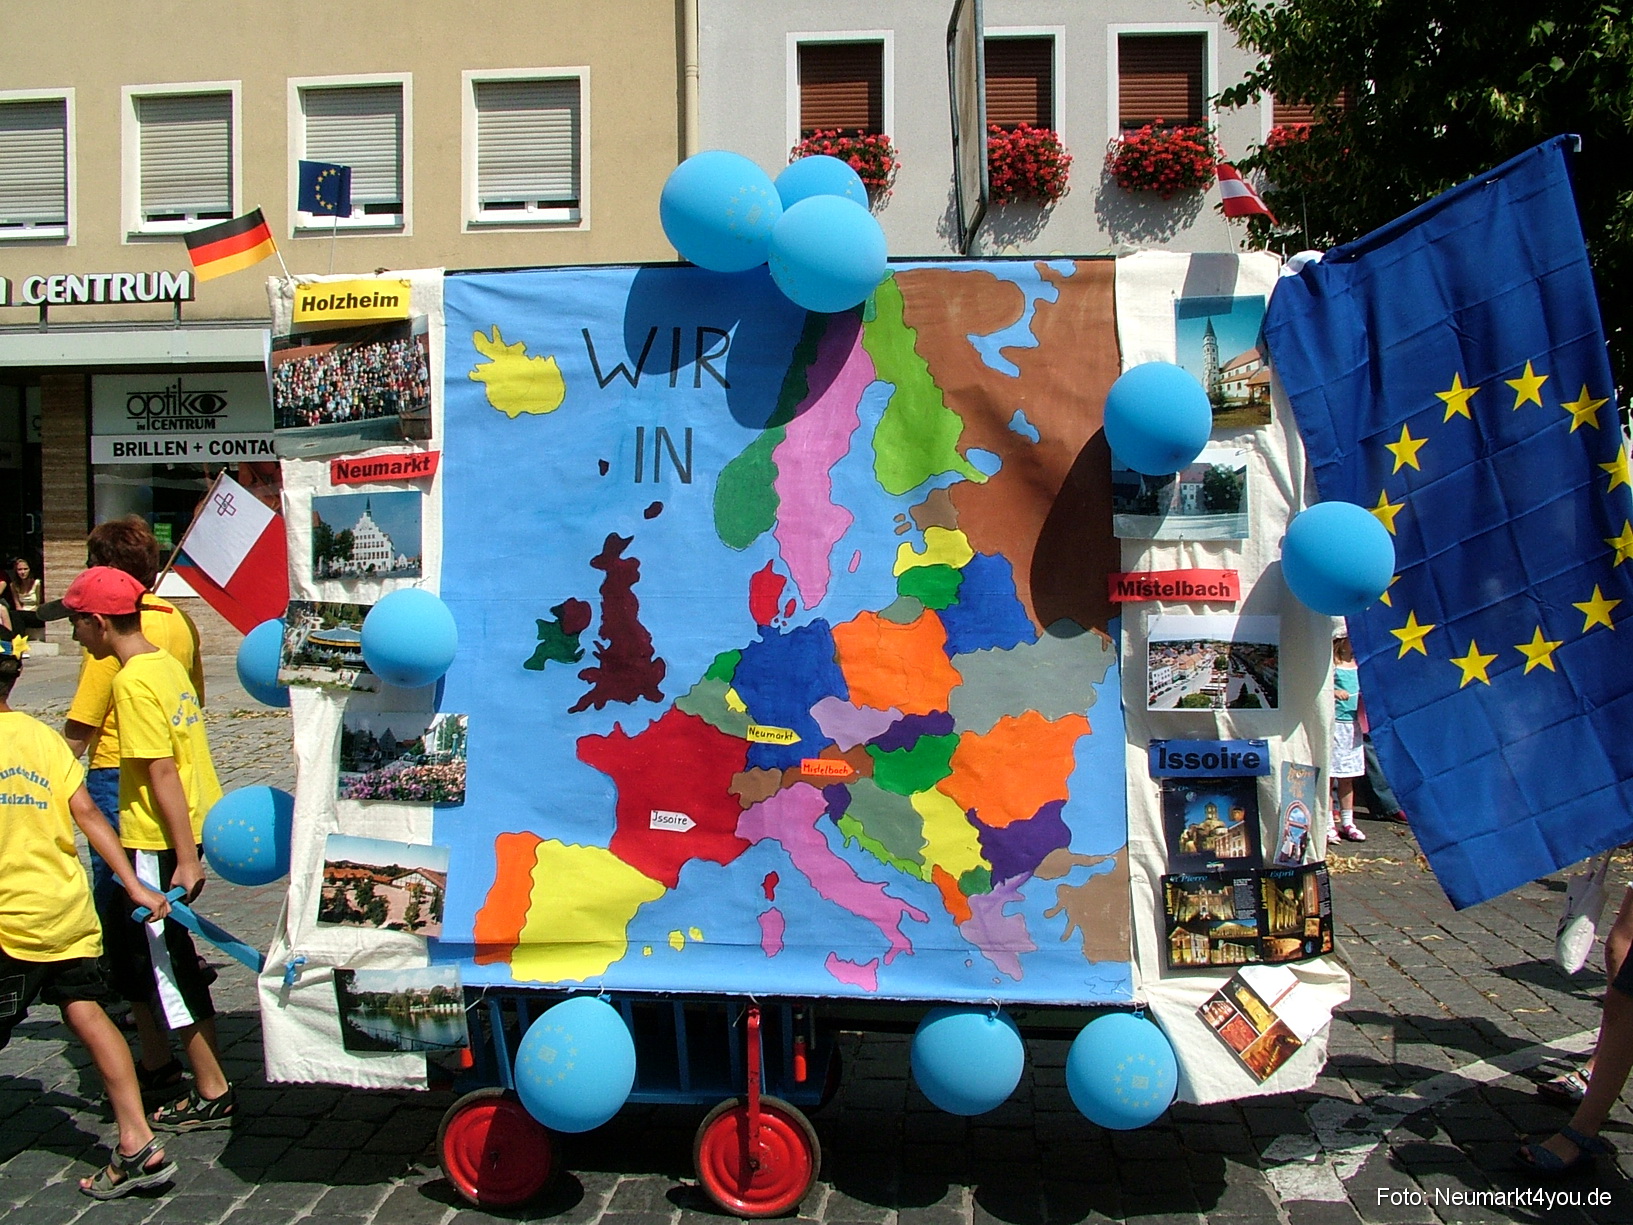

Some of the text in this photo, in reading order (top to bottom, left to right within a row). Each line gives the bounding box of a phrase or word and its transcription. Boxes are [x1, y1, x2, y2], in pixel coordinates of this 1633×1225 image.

[22, 271, 191, 304] CENTRUM
[301, 291, 399, 312] Holzheim
[581, 325, 731, 389] WIR
[151, 418, 216, 430] CENTRUM
[113, 440, 188, 457] BRILLEN
[634, 426, 693, 484] IN
[336, 456, 431, 480] Neumarkt
[1117, 579, 1231, 597] Mistelbach
[748, 727, 793, 741] Neumarkt
[1158, 746, 1260, 770] Issoire
[803, 763, 849, 775] Mistelbach
